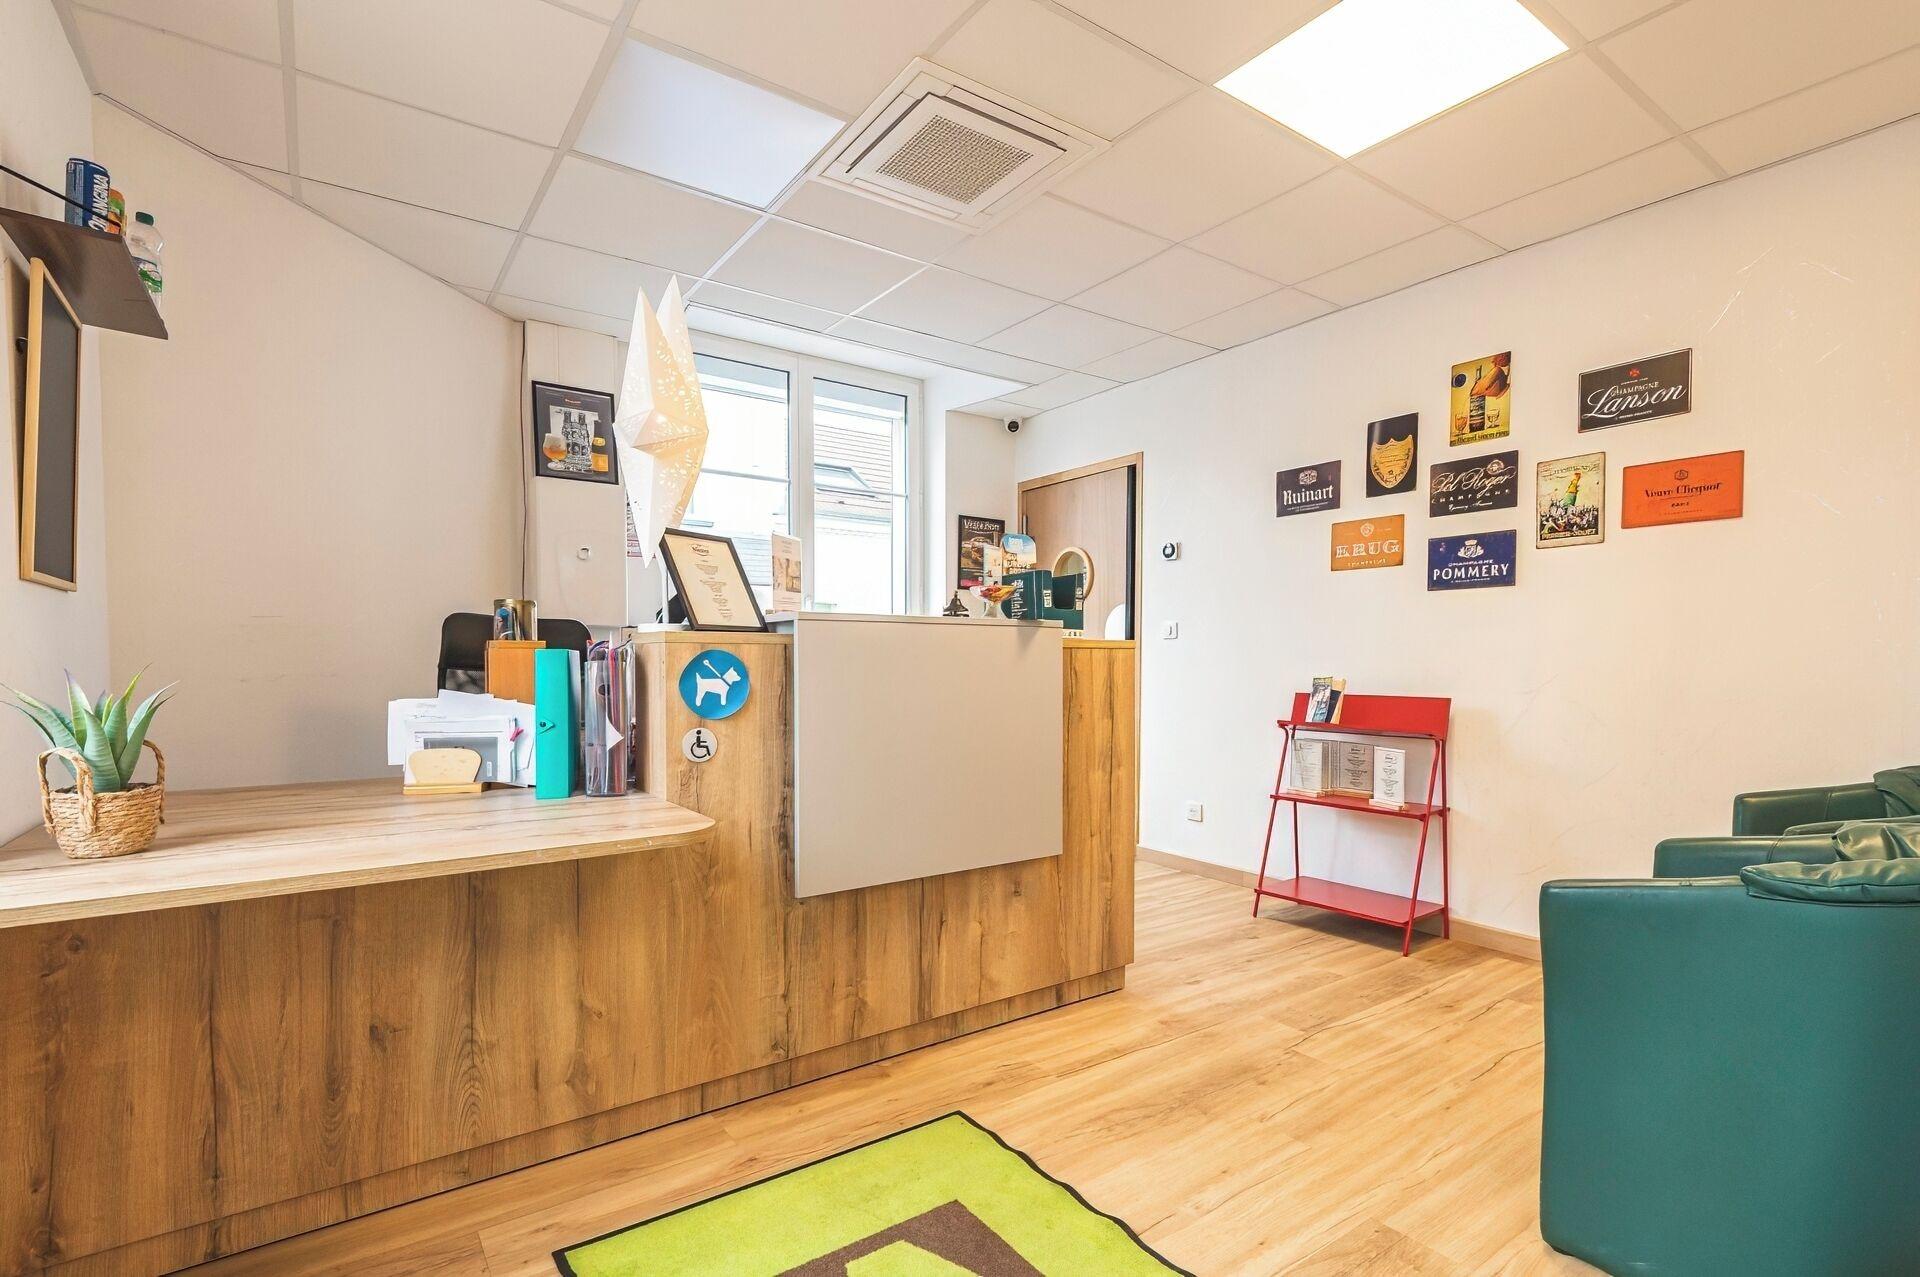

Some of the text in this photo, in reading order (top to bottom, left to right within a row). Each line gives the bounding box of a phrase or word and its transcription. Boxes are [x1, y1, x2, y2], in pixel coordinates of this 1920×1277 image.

[1582, 384, 1687, 418] Lanson
[1283, 484, 1334, 506] Ruinart
[1335, 539, 1400, 559] KRUG
[1433, 563, 1509, 581] POMMERY
